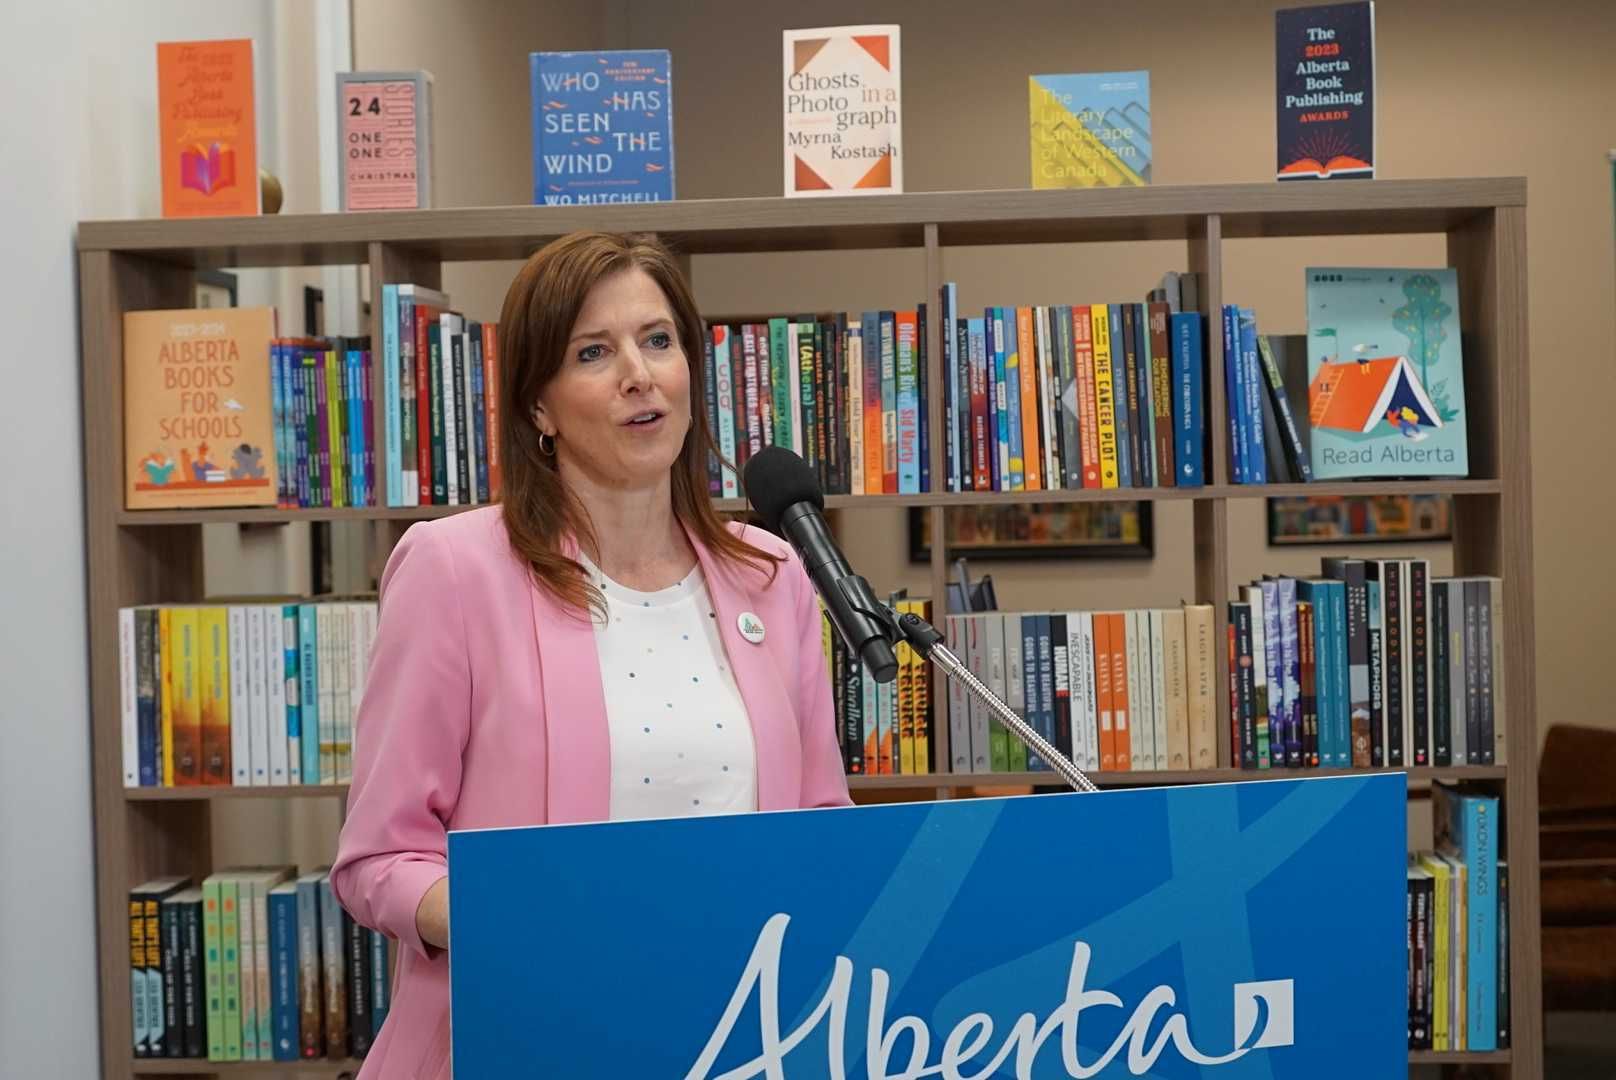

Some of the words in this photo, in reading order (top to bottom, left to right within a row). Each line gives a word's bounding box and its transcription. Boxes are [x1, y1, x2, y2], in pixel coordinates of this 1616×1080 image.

[1306, 28, 1335, 41] The
[1305, 44, 1339, 57] 2023
[1295, 59, 1350, 75] Alberta
[541, 72, 600, 91] WHO
[788, 71, 860, 91] Ghosts
[1306, 76, 1342, 90] Book
[613, 91, 661, 111] HAS
[788, 94, 848, 113] Photo
[862, 83, 882, 103] in
[1040, 88, 1073, 104] The
[1285, 91, 1363, 108] Publishing
[545, 113, 610, 133] SEEN
[836, 107, 897, 131] graph
[1300, 110, 1349, 122] AWARDS
[349, 132, 383, 144] ONE
[613, 132, 662, 152] THE
[788, 131, 841, 148] Myrna
[1041, 126, 1134, 144] Landscape
[349, 147, 383, 159] ONE
[830, 144, 898, 160] Kostash
[543, 154, 613, 174] WIND
[1041, 163, 1107, 179] Canada
[158, 340, 240, 364] ALBERTA
[744, 335, 756, 353] EXIT
[759, 336, 769, 356] end
[898, 322, 915, 373] Oldman's
[760, 359, 770, 386] times
[1096, 352, 1109, 374] THE
[164, 366, 235, 389] BOOKS
[745, 355, 758, 408] STRATEGIES
[800, 345, 815, 406] (Athena)
[180, 391, 219, 415] FOR
[1099, 380, 1112, 426] CANCER
[159, 416, 242, 440] SCHOOLS
[750, 415, 761, 437] PAUL
[764, 403, 774, 445] michelle
[901, 408, 915, 427] Sid
[1102, 432, 1115, 462] PLOT
[1323, 447, 1373, 465] Read
[1380, 444, 1455, 464] Alberta
[1390, 617, 1398, 657] BODY
[1415, 616, 1424, 657] BODY
[1025, 637, 1035, 660] GOING
[1040, 636, 1049, 660] GOING
[1026, 662, 1036, 672] TO
[1041, 662, 1050, 672] TO
[1055, 646, 1071, 698] HUMANE
[1071, 632, 1083, 702] INESCAPABLE
[1113, 652, 1124, 693] KALYNA
[1372, 632, 1382, 710] METAPHORS
[1027, 674, 1038, 713] BEAUTIFUL
[1042, 673, 1052, 712] BEAUTIFUL
[846, 676, 861, 740] Swallow
[1476, 855, 1489, 897] WINGS
[684, 912, 1252, 1080] Alberta
